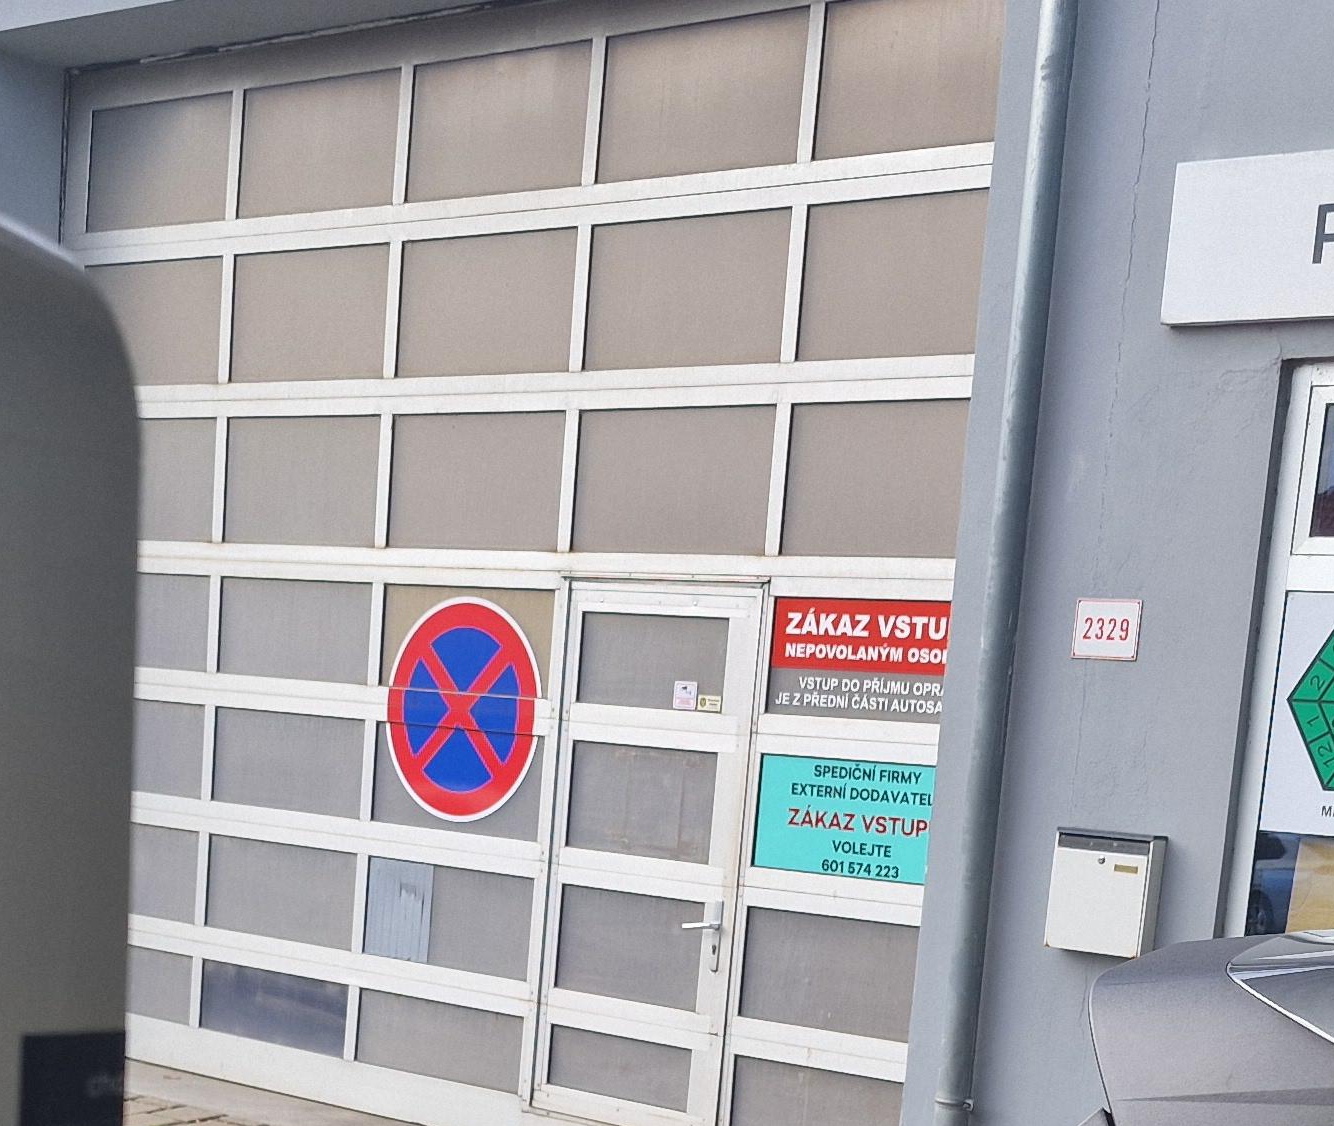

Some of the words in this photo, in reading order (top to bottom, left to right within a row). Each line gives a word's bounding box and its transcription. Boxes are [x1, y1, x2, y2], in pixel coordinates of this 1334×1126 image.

[785, 607, 871, 638] ZÁKAZ
[878, 614, 949, 640] VSTU
[1082, 617, 1130, 642] 2329
[784, 642, 903, 663] NEPOVOLANÝM
[799, 677, 838, 691] VSTUP
[842, 679, 860, 692] DO
[863, 677, 909, 695] PŘÍJMU
[1309, 675, 1327, 692] 2
[775, 691, 789, 705] JE
[792, 693, 801, 705] Z
[803, 692, 848, 709] PŘEDNÍ
[851, 693, 888, 711] ČÁSTI
[1317, 741, 1334, 768] 12
[814, 764, 876, 782] SPEDIČNÍ
[879, 769, 922, 785] FIRMY
[791, 782, 846, 800] EXTERNÍ
[788, 805, 856, 831] ZÁKAZ
[832, 840, 892, 858] VOLEJTE
[821, 859, 844, 874] 601
[848, 862, 872, 876] 574
[875, 865, 900, 879] 223
